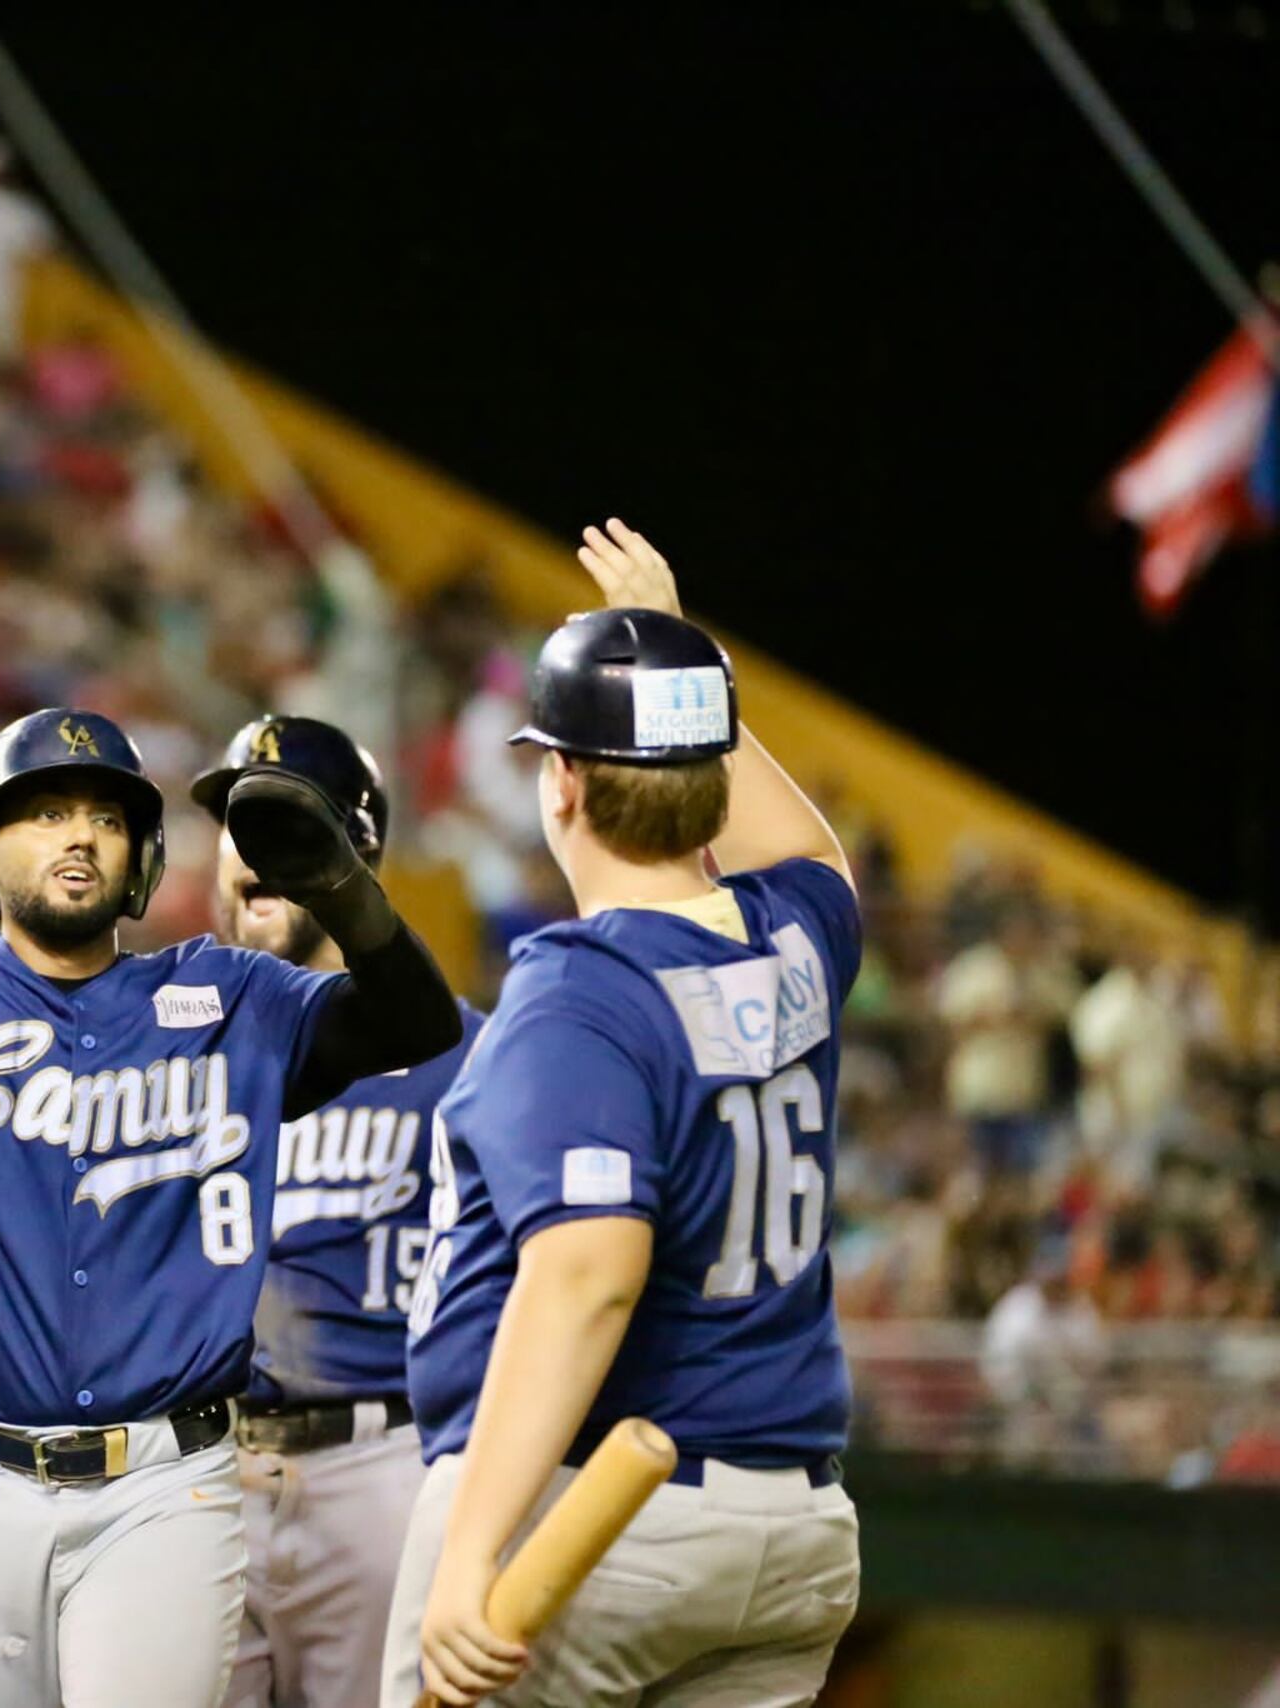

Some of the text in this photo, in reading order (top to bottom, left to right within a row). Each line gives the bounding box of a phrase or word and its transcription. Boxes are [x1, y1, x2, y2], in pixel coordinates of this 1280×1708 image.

[199, 1171, 254, 1265] 8
[702, 1063, 825, 1300] 16
[362, 1225, 429, 1315] 15
